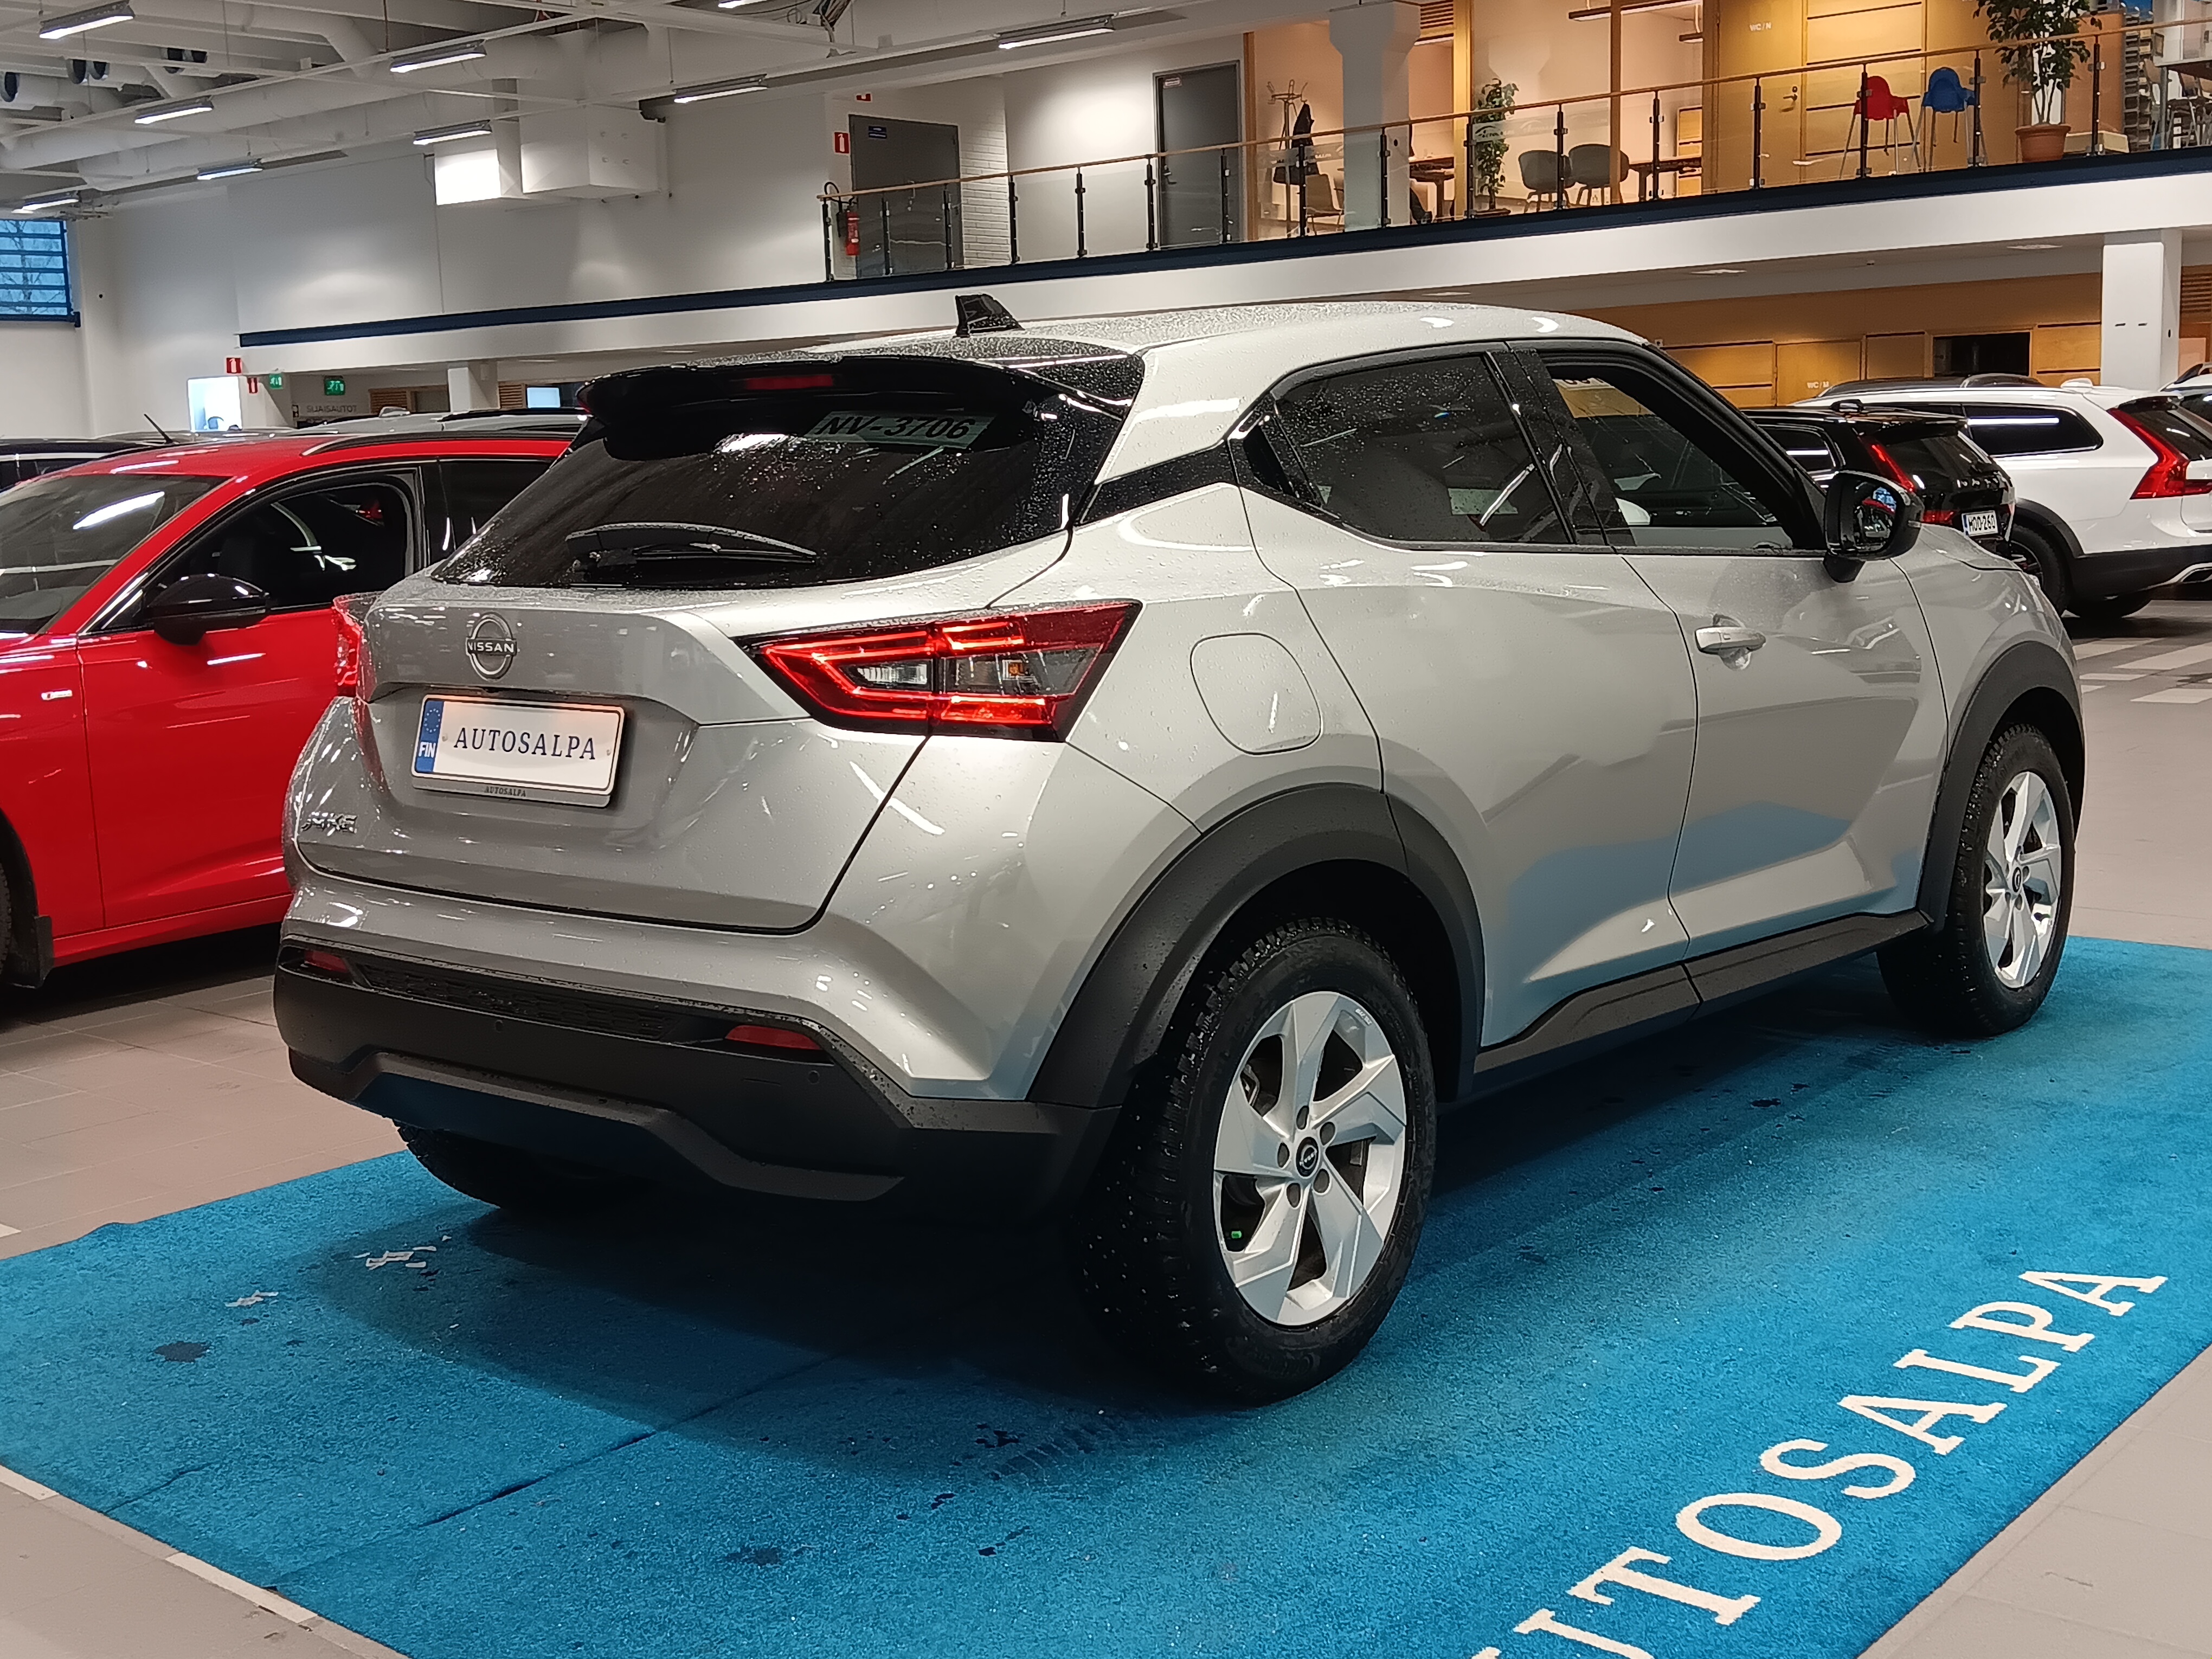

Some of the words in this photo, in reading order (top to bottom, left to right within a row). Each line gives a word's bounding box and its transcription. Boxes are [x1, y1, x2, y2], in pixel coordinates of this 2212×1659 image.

[814, 416, 976, 439] NV-3706
[468, 641, 514, 653] NISSAN
[419, 741, 436, 758] FIN
[453, 727, 596, 760] AUTOSALPA
[484, 786, 526, 797] AUTOSALPA
